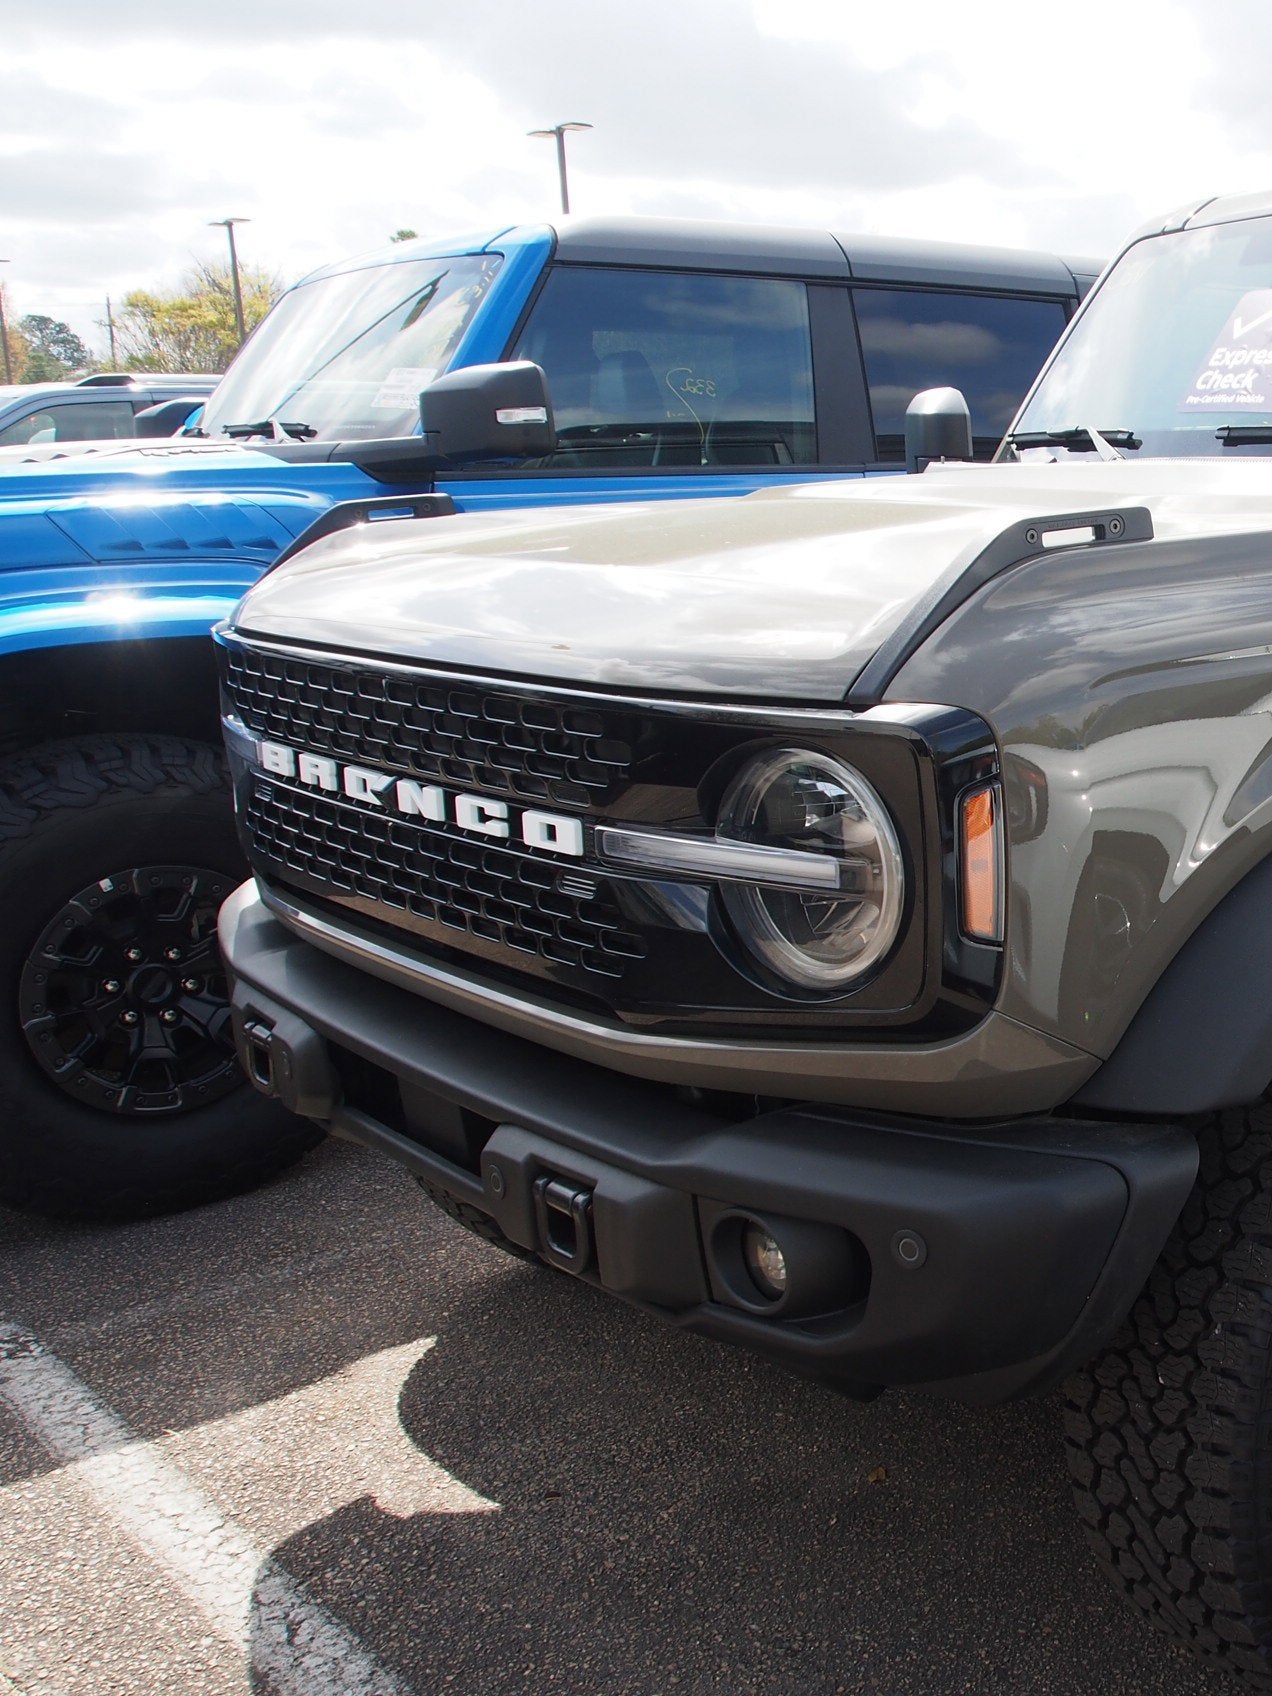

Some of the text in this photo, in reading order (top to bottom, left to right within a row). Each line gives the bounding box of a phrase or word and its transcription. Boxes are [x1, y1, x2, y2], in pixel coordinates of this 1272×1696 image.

[1196, 369, 1259, 391] Check
[1185, 394, 1266, 405] Pre-Certified Vehicle
[260, 740, 585, 857] BRONCO
